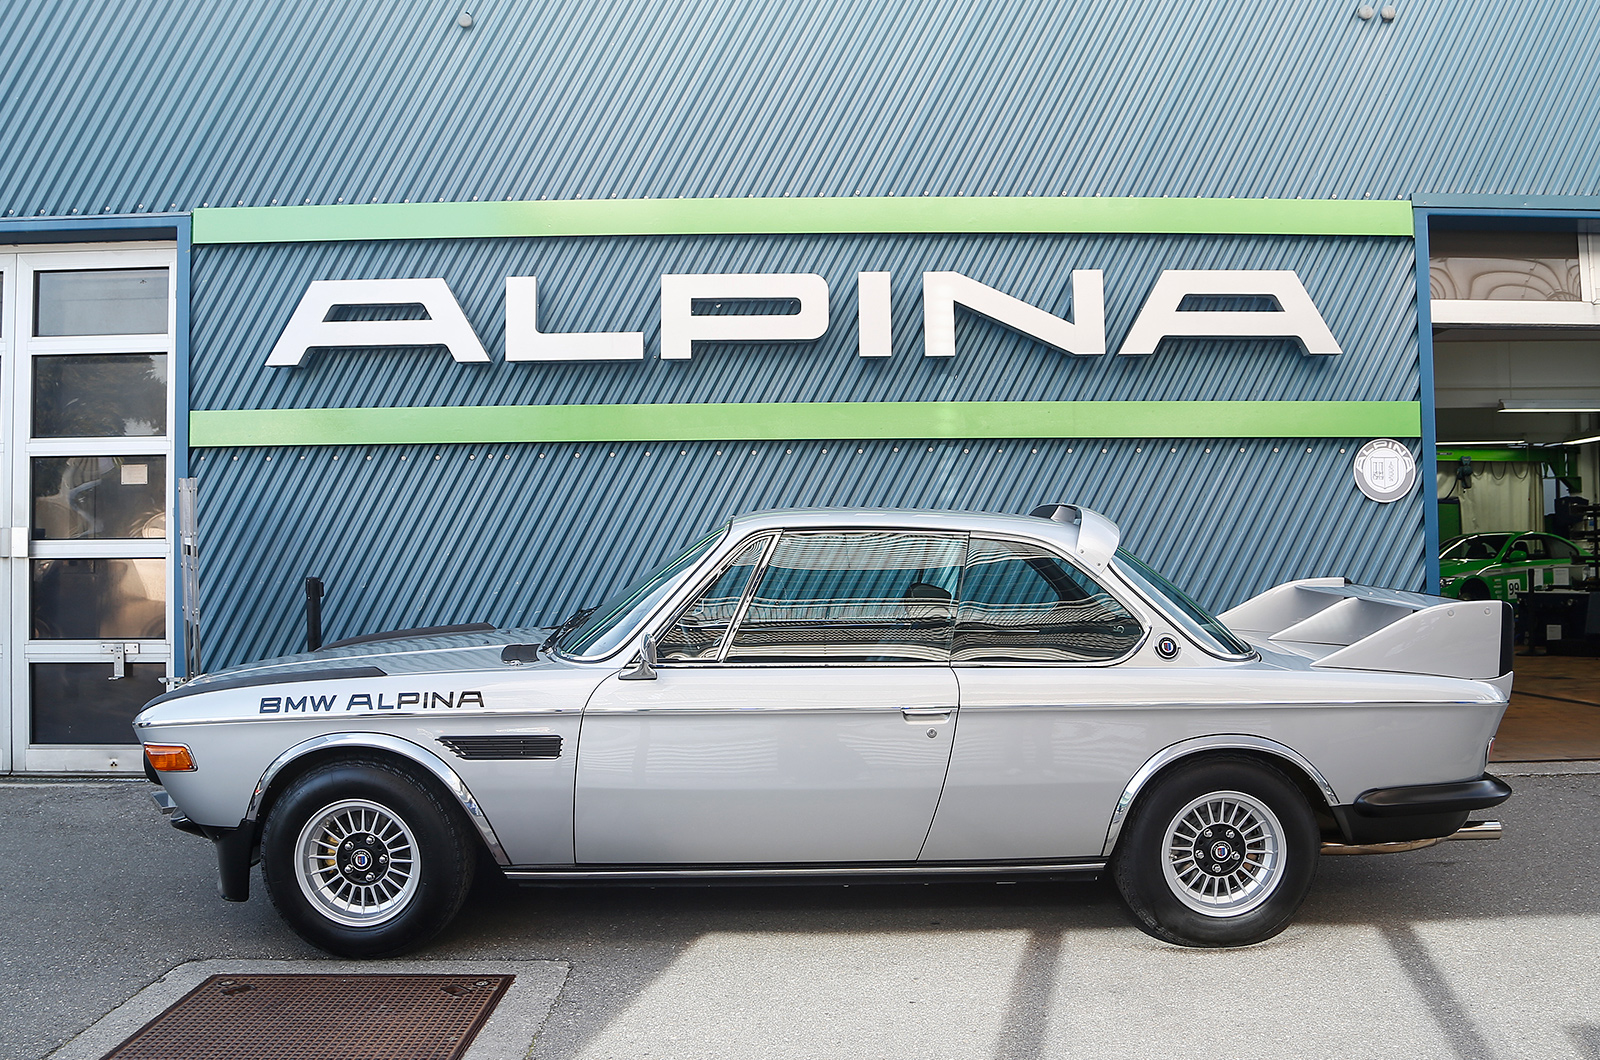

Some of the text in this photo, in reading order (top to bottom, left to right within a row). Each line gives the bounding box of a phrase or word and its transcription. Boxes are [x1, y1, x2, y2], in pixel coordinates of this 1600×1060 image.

[265, 269, 1342, 367] ALPINA
[1356, 440, 1413, 473] ALPINA
[1508, 582, 1520, 596] 99
[259, 690, 485, 714] BMW ALPINA
